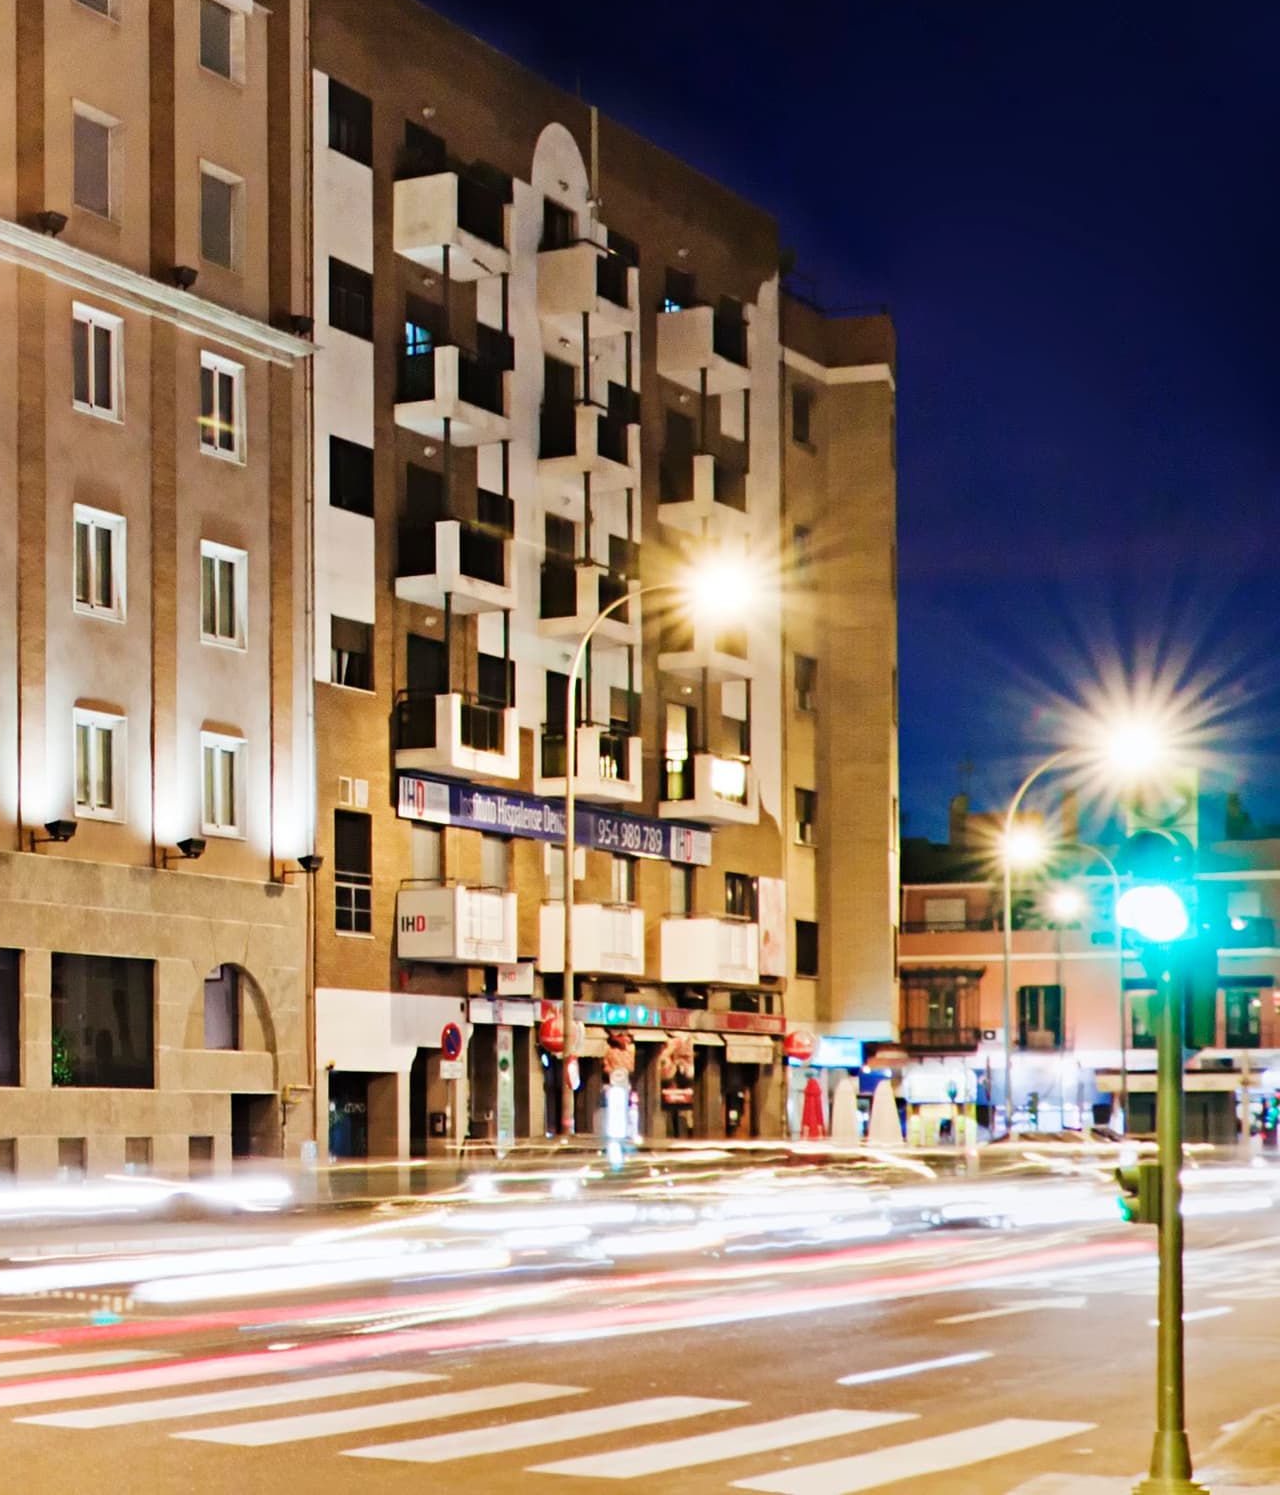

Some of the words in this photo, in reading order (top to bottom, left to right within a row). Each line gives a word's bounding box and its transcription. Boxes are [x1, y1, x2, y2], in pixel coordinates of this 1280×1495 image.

[402, 778, 425, 816] IHD
[598, 819, 619, 846] 954
[621, 823, 641, 850] 989
[643, 826, 663, 853] 789
[401, 915, 426, 932] IHD
